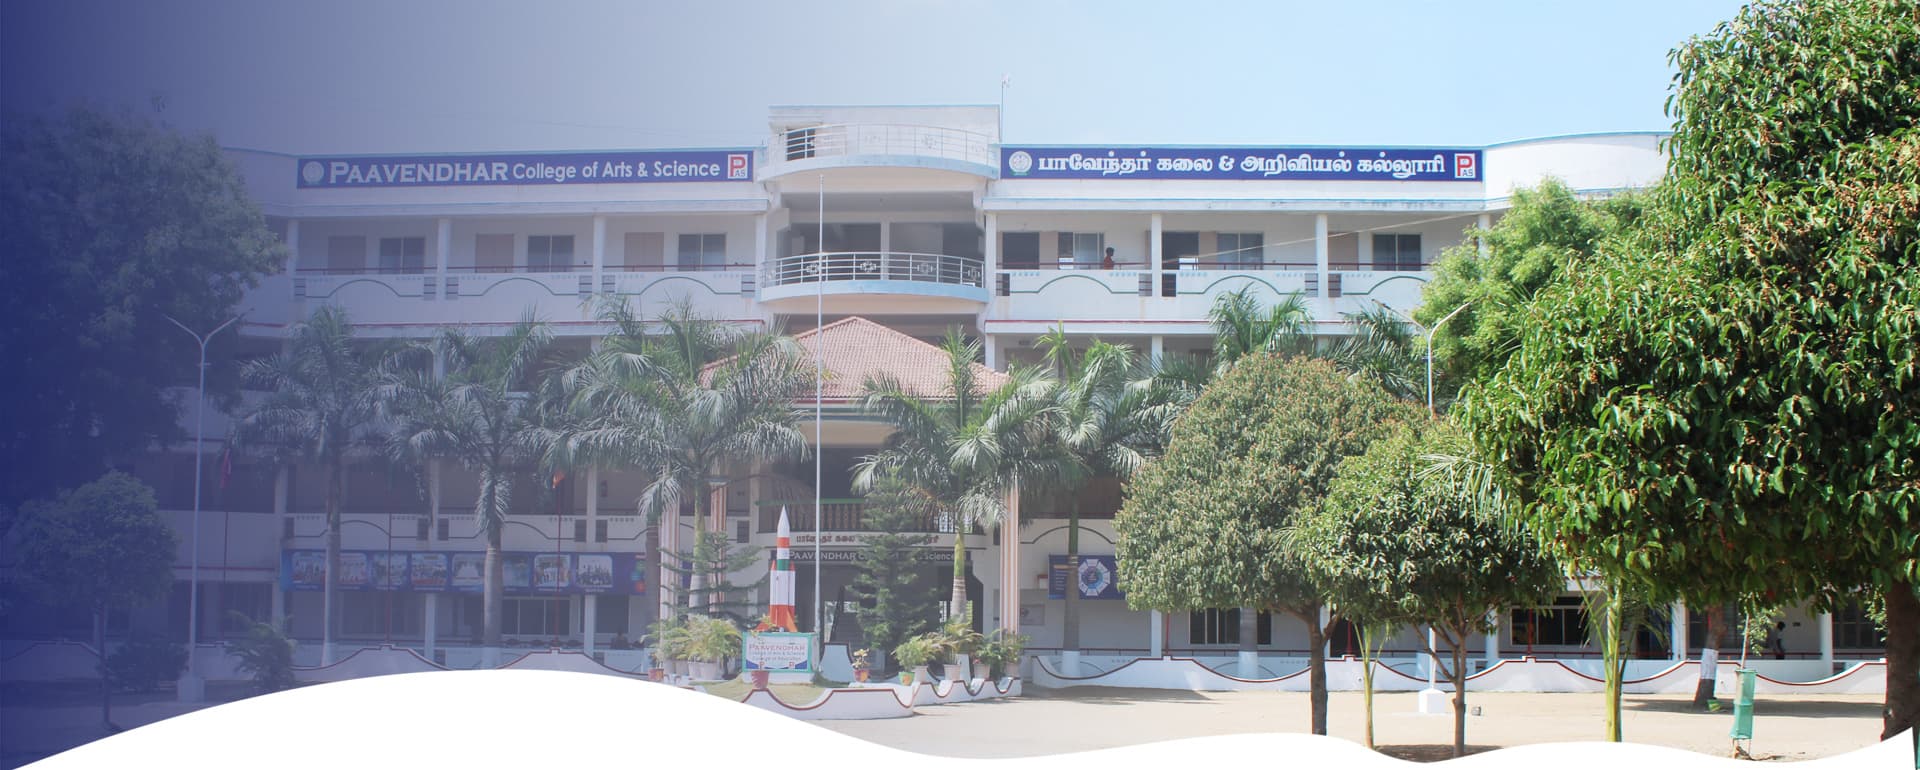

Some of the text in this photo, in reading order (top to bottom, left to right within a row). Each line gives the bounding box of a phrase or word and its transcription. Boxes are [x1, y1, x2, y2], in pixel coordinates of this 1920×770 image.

[329, 159, 721, 184] PAAVENDHAR College of Arts & Science
[1038, 151, 1445, 179] பாவேந்தர் கலை & அறிவியல் கல்லூரி
